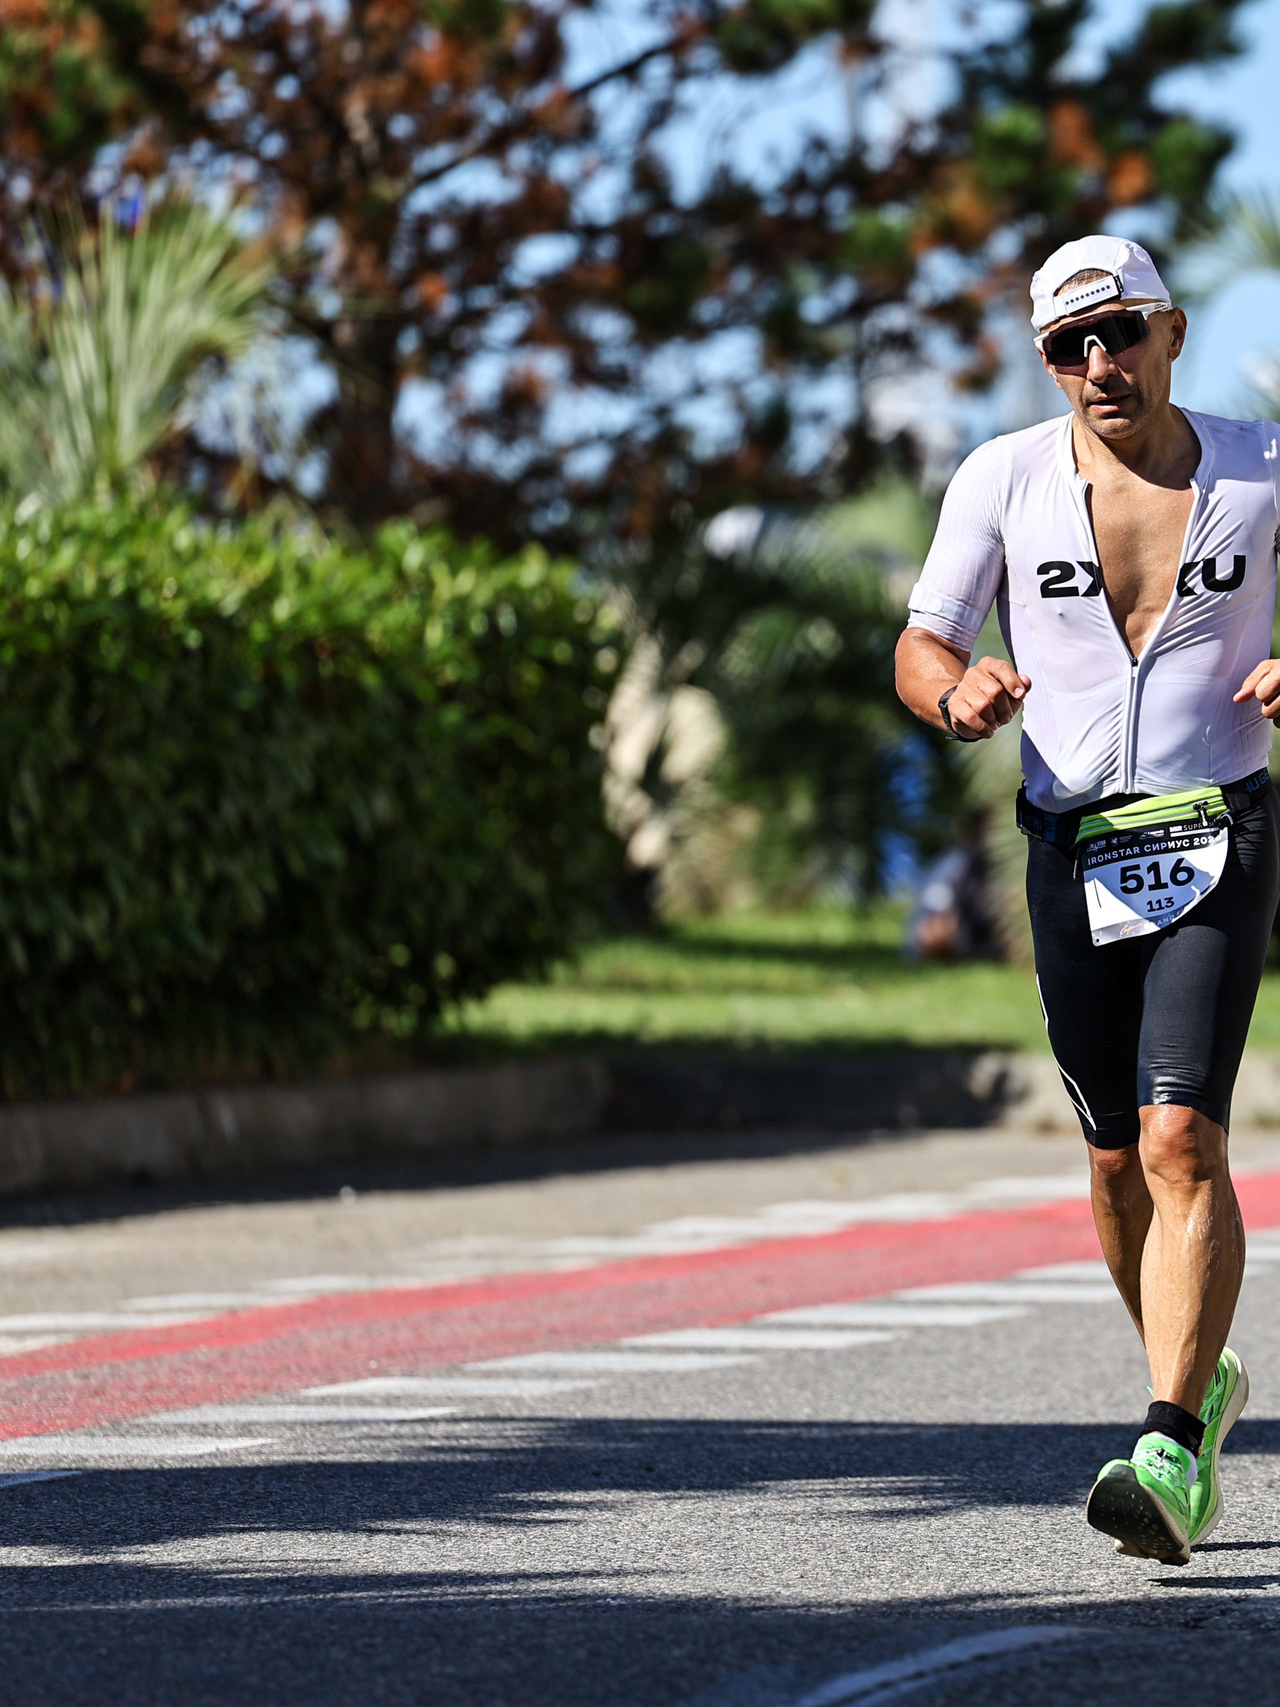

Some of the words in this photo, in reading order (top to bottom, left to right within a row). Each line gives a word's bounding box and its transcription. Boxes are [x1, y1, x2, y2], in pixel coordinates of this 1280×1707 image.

[1087, 844, 1141, 866] IRONSTAR
[1143, 838, 1190, 853] СИРИУС
[1119, 857, 1196, 895] 516
[1146, 896, 1175, 913] 113
